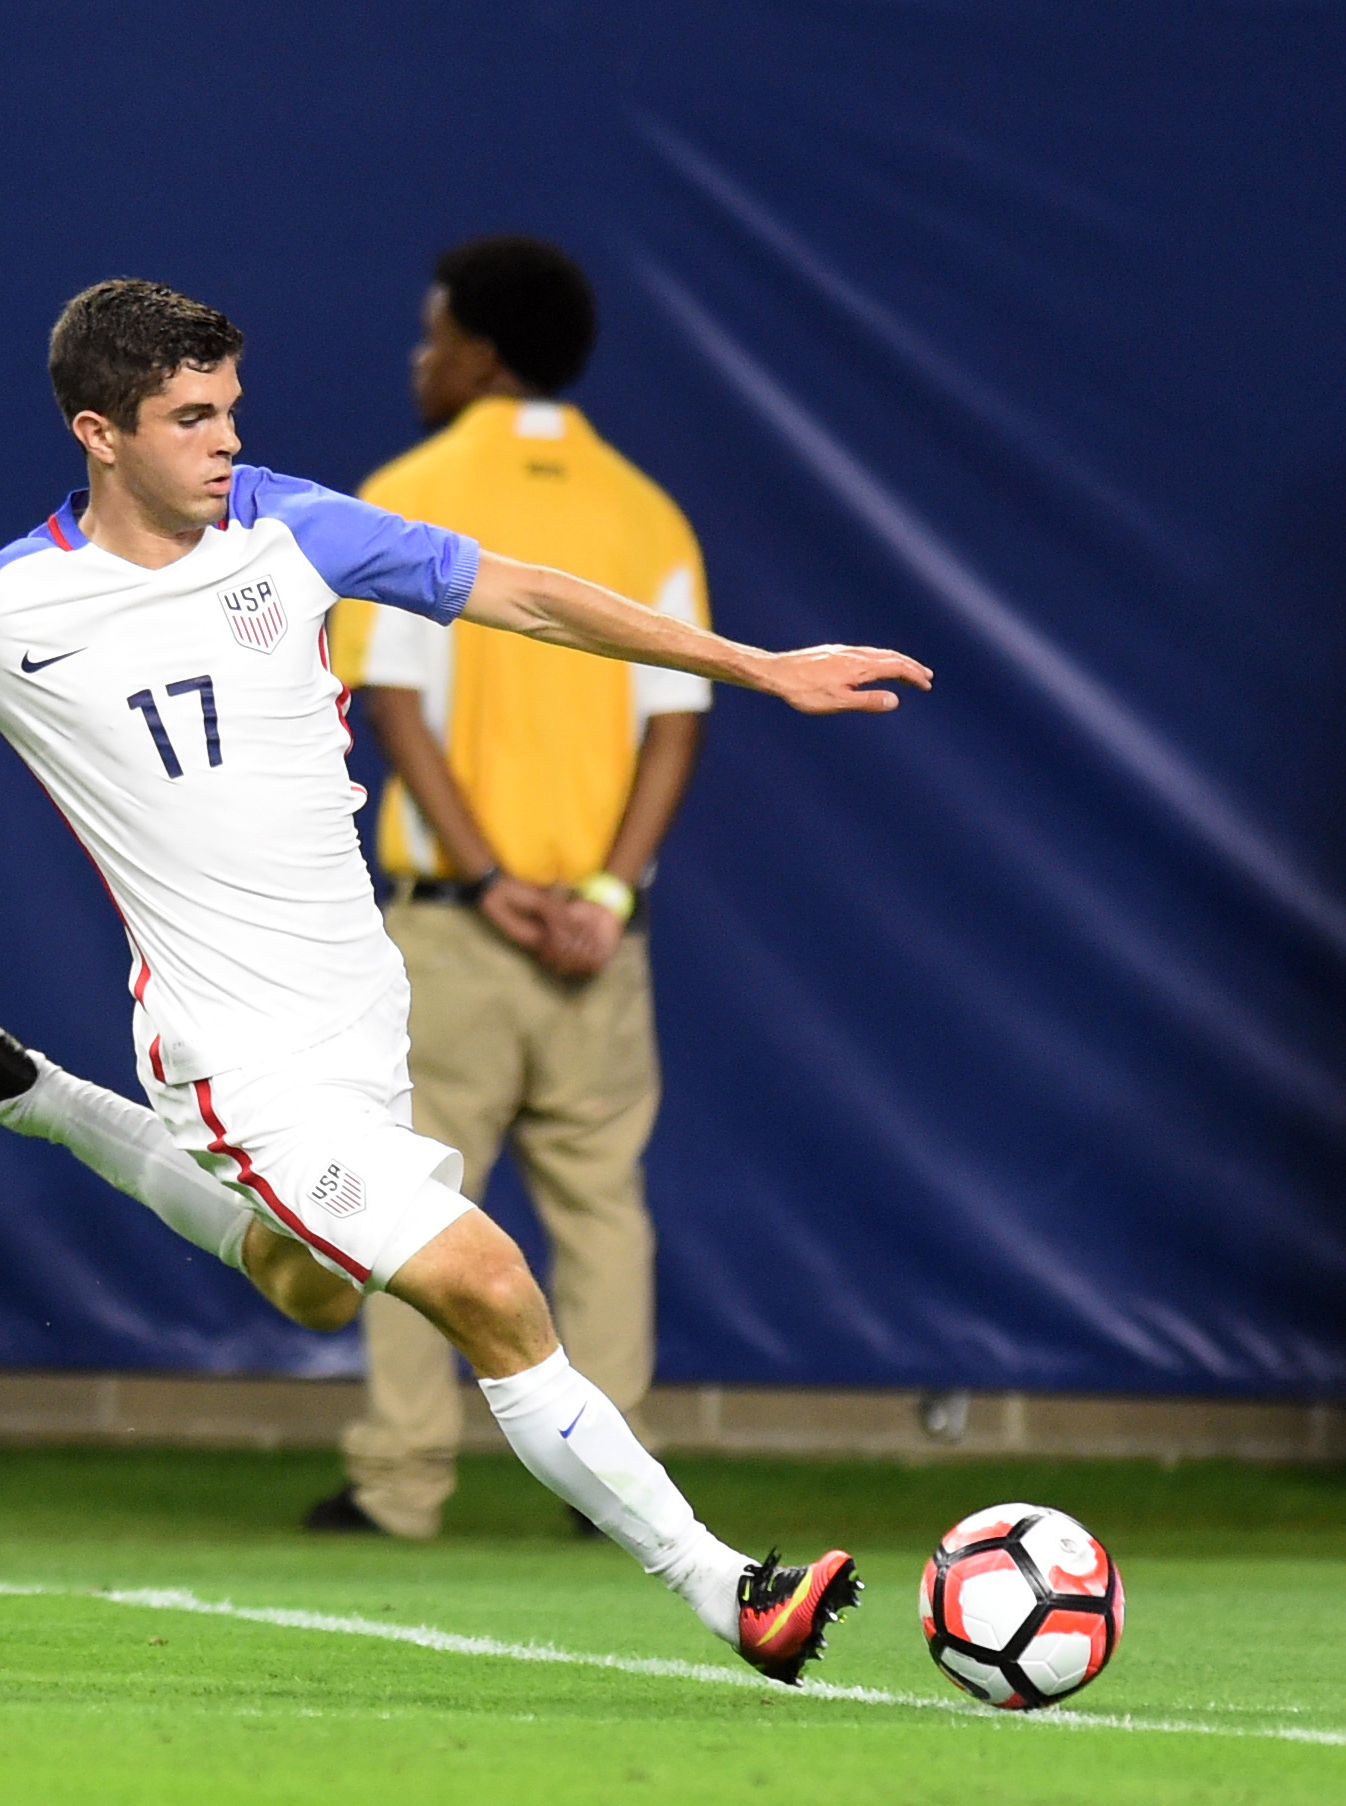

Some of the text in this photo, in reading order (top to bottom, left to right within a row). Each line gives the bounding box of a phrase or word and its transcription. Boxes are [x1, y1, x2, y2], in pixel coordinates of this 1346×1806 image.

[224, 581, 272, 612] USA
[126, 674, 223, 779] 17
[311, 1164, 341, 1200] USA
